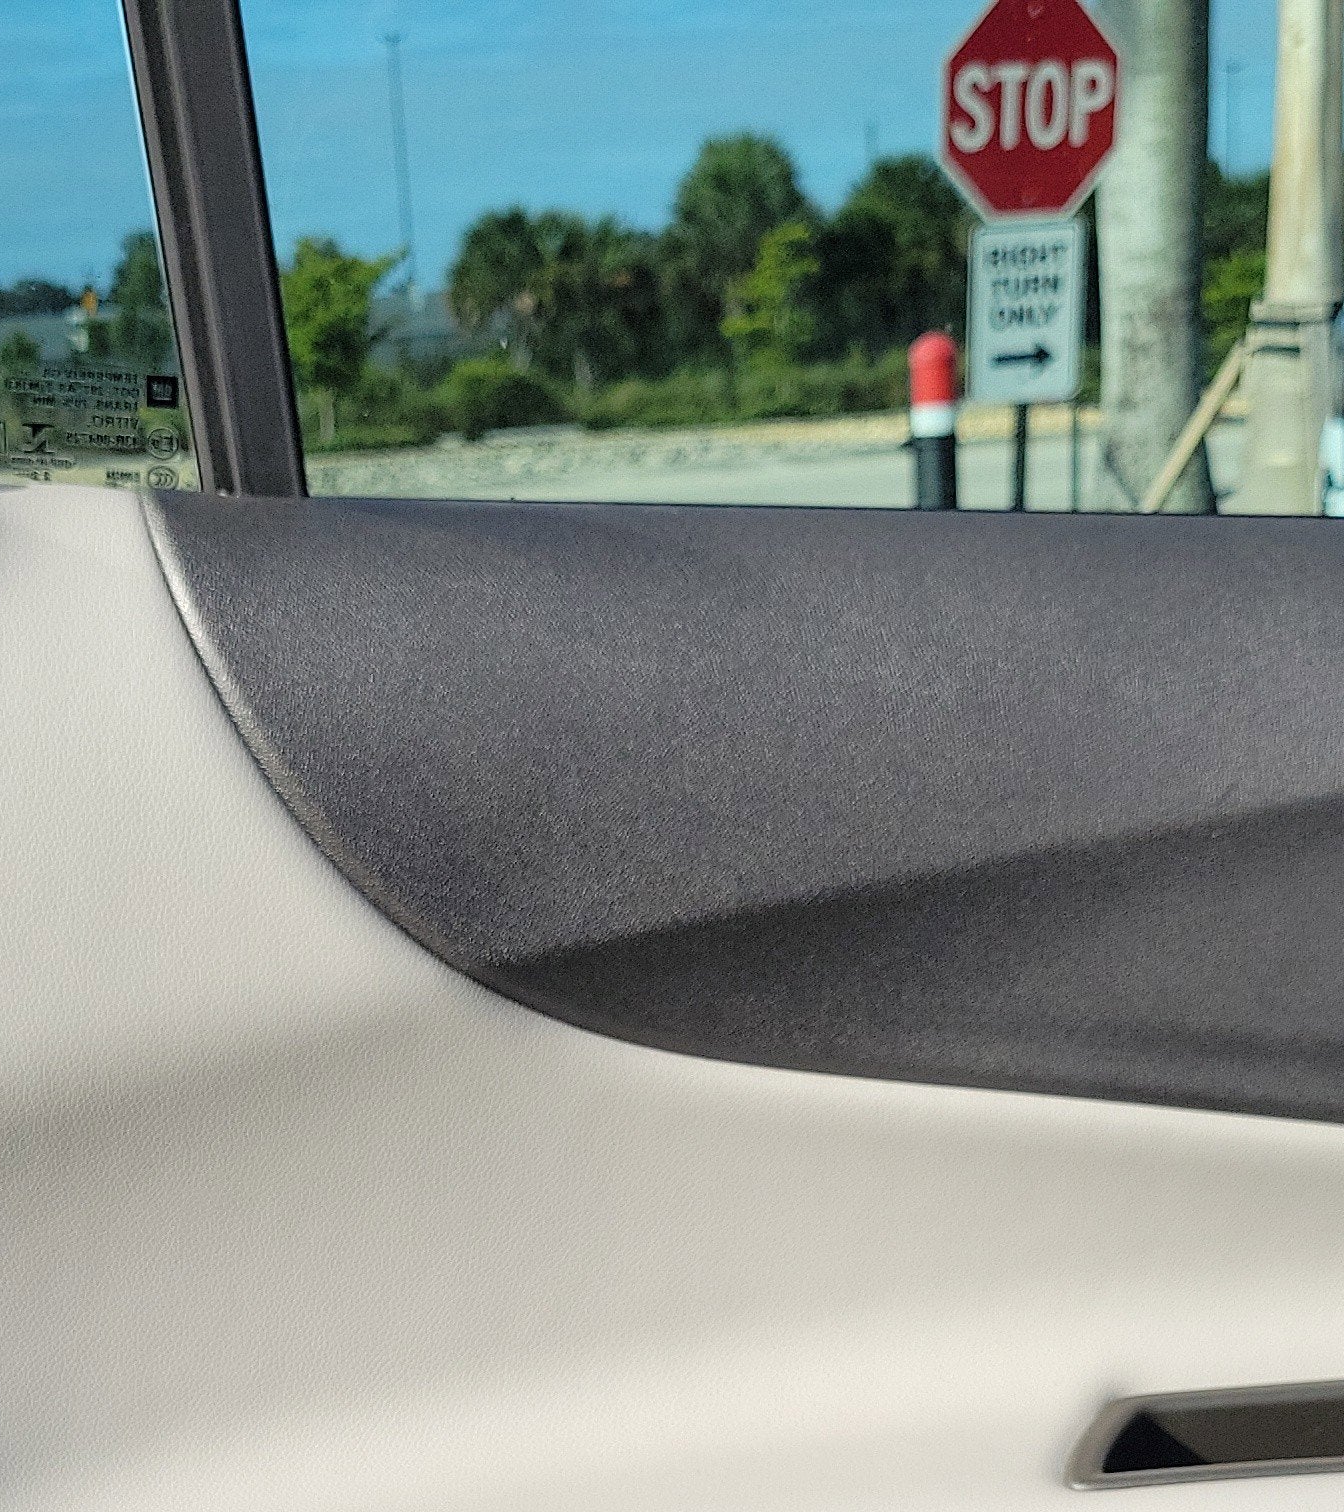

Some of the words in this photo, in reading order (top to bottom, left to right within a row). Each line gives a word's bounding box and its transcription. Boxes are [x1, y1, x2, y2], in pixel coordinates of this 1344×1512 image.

[950, 59, 1113, 153] STOP
[991, 275, 1061, 299] TURN
[989, 304, 1061, 332] ONLY
